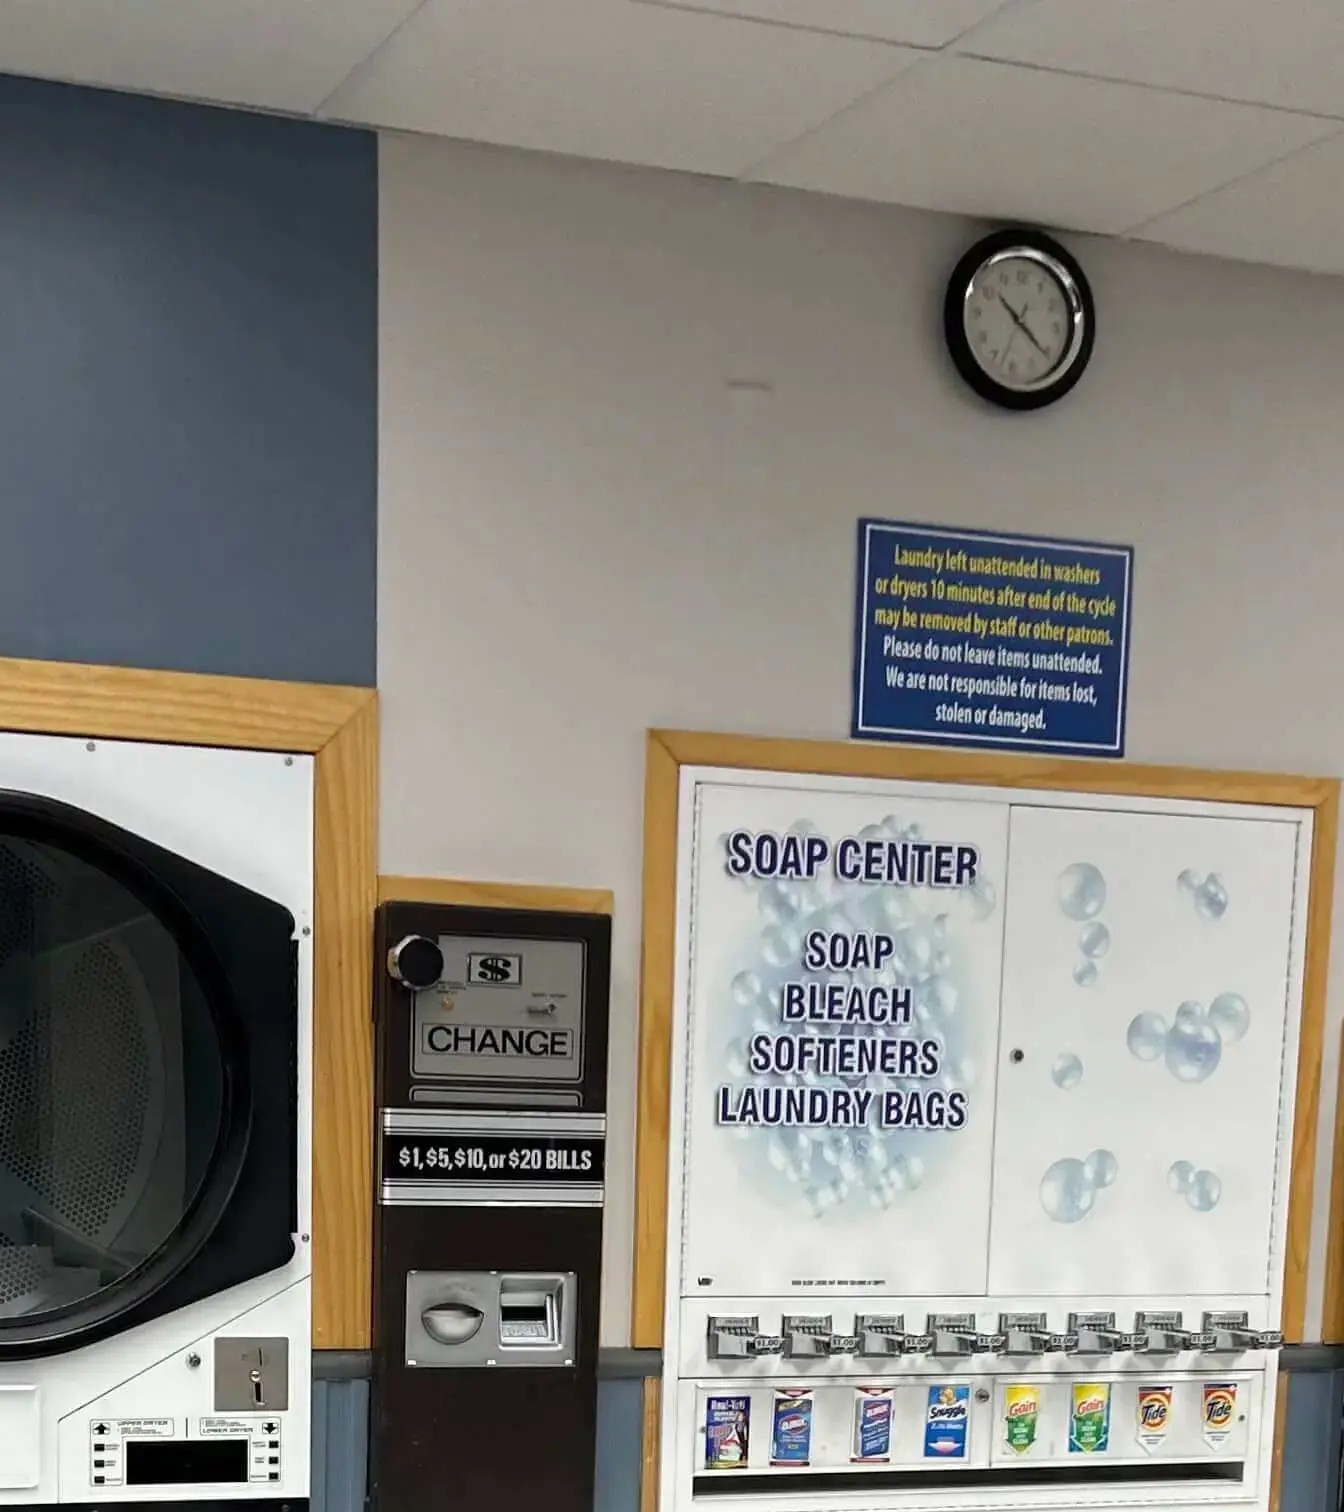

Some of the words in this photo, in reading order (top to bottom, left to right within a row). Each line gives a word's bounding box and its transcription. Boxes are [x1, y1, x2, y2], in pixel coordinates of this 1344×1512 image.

[895, 544, 944, 573] Laundry
[946, 550, 967, 571] left
[970, 554, 1037, 578] unattended
[1040, 559, 1052, 578] in
[1054, 563, 1100, 585] washers
[876, 579, 888, 594] or
[890, 576, 927, 600] dryers
[931, 579, 944, 599] 10
[946, 583, 995, 605] minutes
[996, 586, 1025, 608] after
[1028, 590, 1050, 610] end
[1052, 592, 1065, 611] of
[1066, 594, 1086, 613] the
[1088, 597, 1116, 619] cycle
[875, 609, 900, 630] may
[902, 609, 917, 627] be
[919, 611, 971, 633] removed
[974, 614, 988, 639] by
[989, 616, 1017, 637] staff
[1019, 623, 1031, 639] or
[1033, 619, 1065, 640] other
[1066, 624, 1113, 647] patrons.
[883, 635, 922, 658] Please
[924, 639, 939, 660] do
[942, 643, 962, 662] not
[964, 643, 995, 665] leave
[997, 645, 1030, 668] items
[1032, 649, 1103, 675] unattended.
[886, 666, 904, 688] We
[906, 673, 926, 690] are
[928, 673, 949, 692] not
[951, 674, 1017, 698] responsible
[1020, 680, 1037, 700] for
[1039, 682, 1070, 703] items
[1072, 684, 1097, 707] lost,
[936, 701, 972, 724] stolen
[975, 708, 987, 724] or
[989, 704, 1046, 733] damaged.
[729, 833, 828, 877] SOAP
[838, 839, 978, 885] CENTER
[807, 932, 893, 970] SOAP
[478, 957, 511, 982] $
[784, 984, 912, 1023] BLEACH
[427, 1026, 568, 1056] CHANGE
[752, 1036, 938, 1076] SOFTENERS
[719, 1087, 873, 1126] LAUNDRY
[882, 1091, 967, 1130] BAGS
[489, 1153, 506, 1169] or
[508, 1148, 541, 1170] $20
[546, 1150, 592, 1170] BILLS
[756, 1339, 779, 1348] $1.00
[930, 1404, 966, 1419] Snuggle
[1009, 1401, 1037, 1416] Gain
[1078, 1398, 1105, 1414] Gain
[1141, 1403, 1167, 1424] Tide
[1207, 1400, 1232, 1422] Tide
